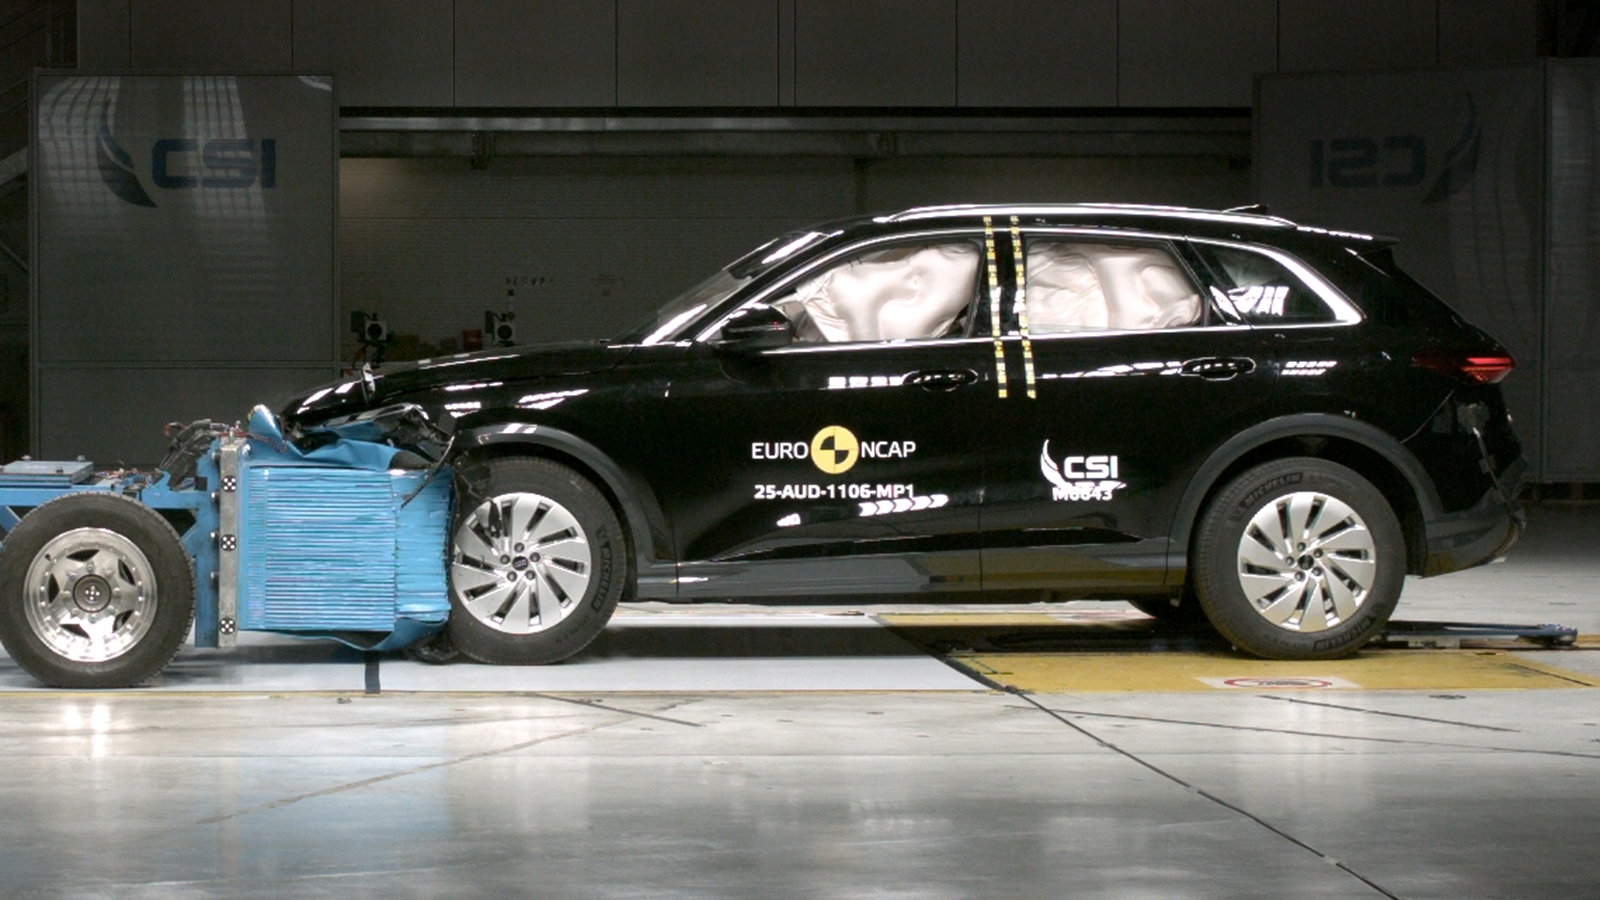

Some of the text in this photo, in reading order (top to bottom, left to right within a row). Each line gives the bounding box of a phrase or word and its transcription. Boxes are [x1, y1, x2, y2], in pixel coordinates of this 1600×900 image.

[152, 138, 276, 188] CSI
[751, 441, 916, 459] EURO NCAP
[1064, 455, 1119, 479] CSI
[754, 484, 913, 499] 25-AUD-1106-MP1
[1243, 473, 1302, 507] MICHELIN
